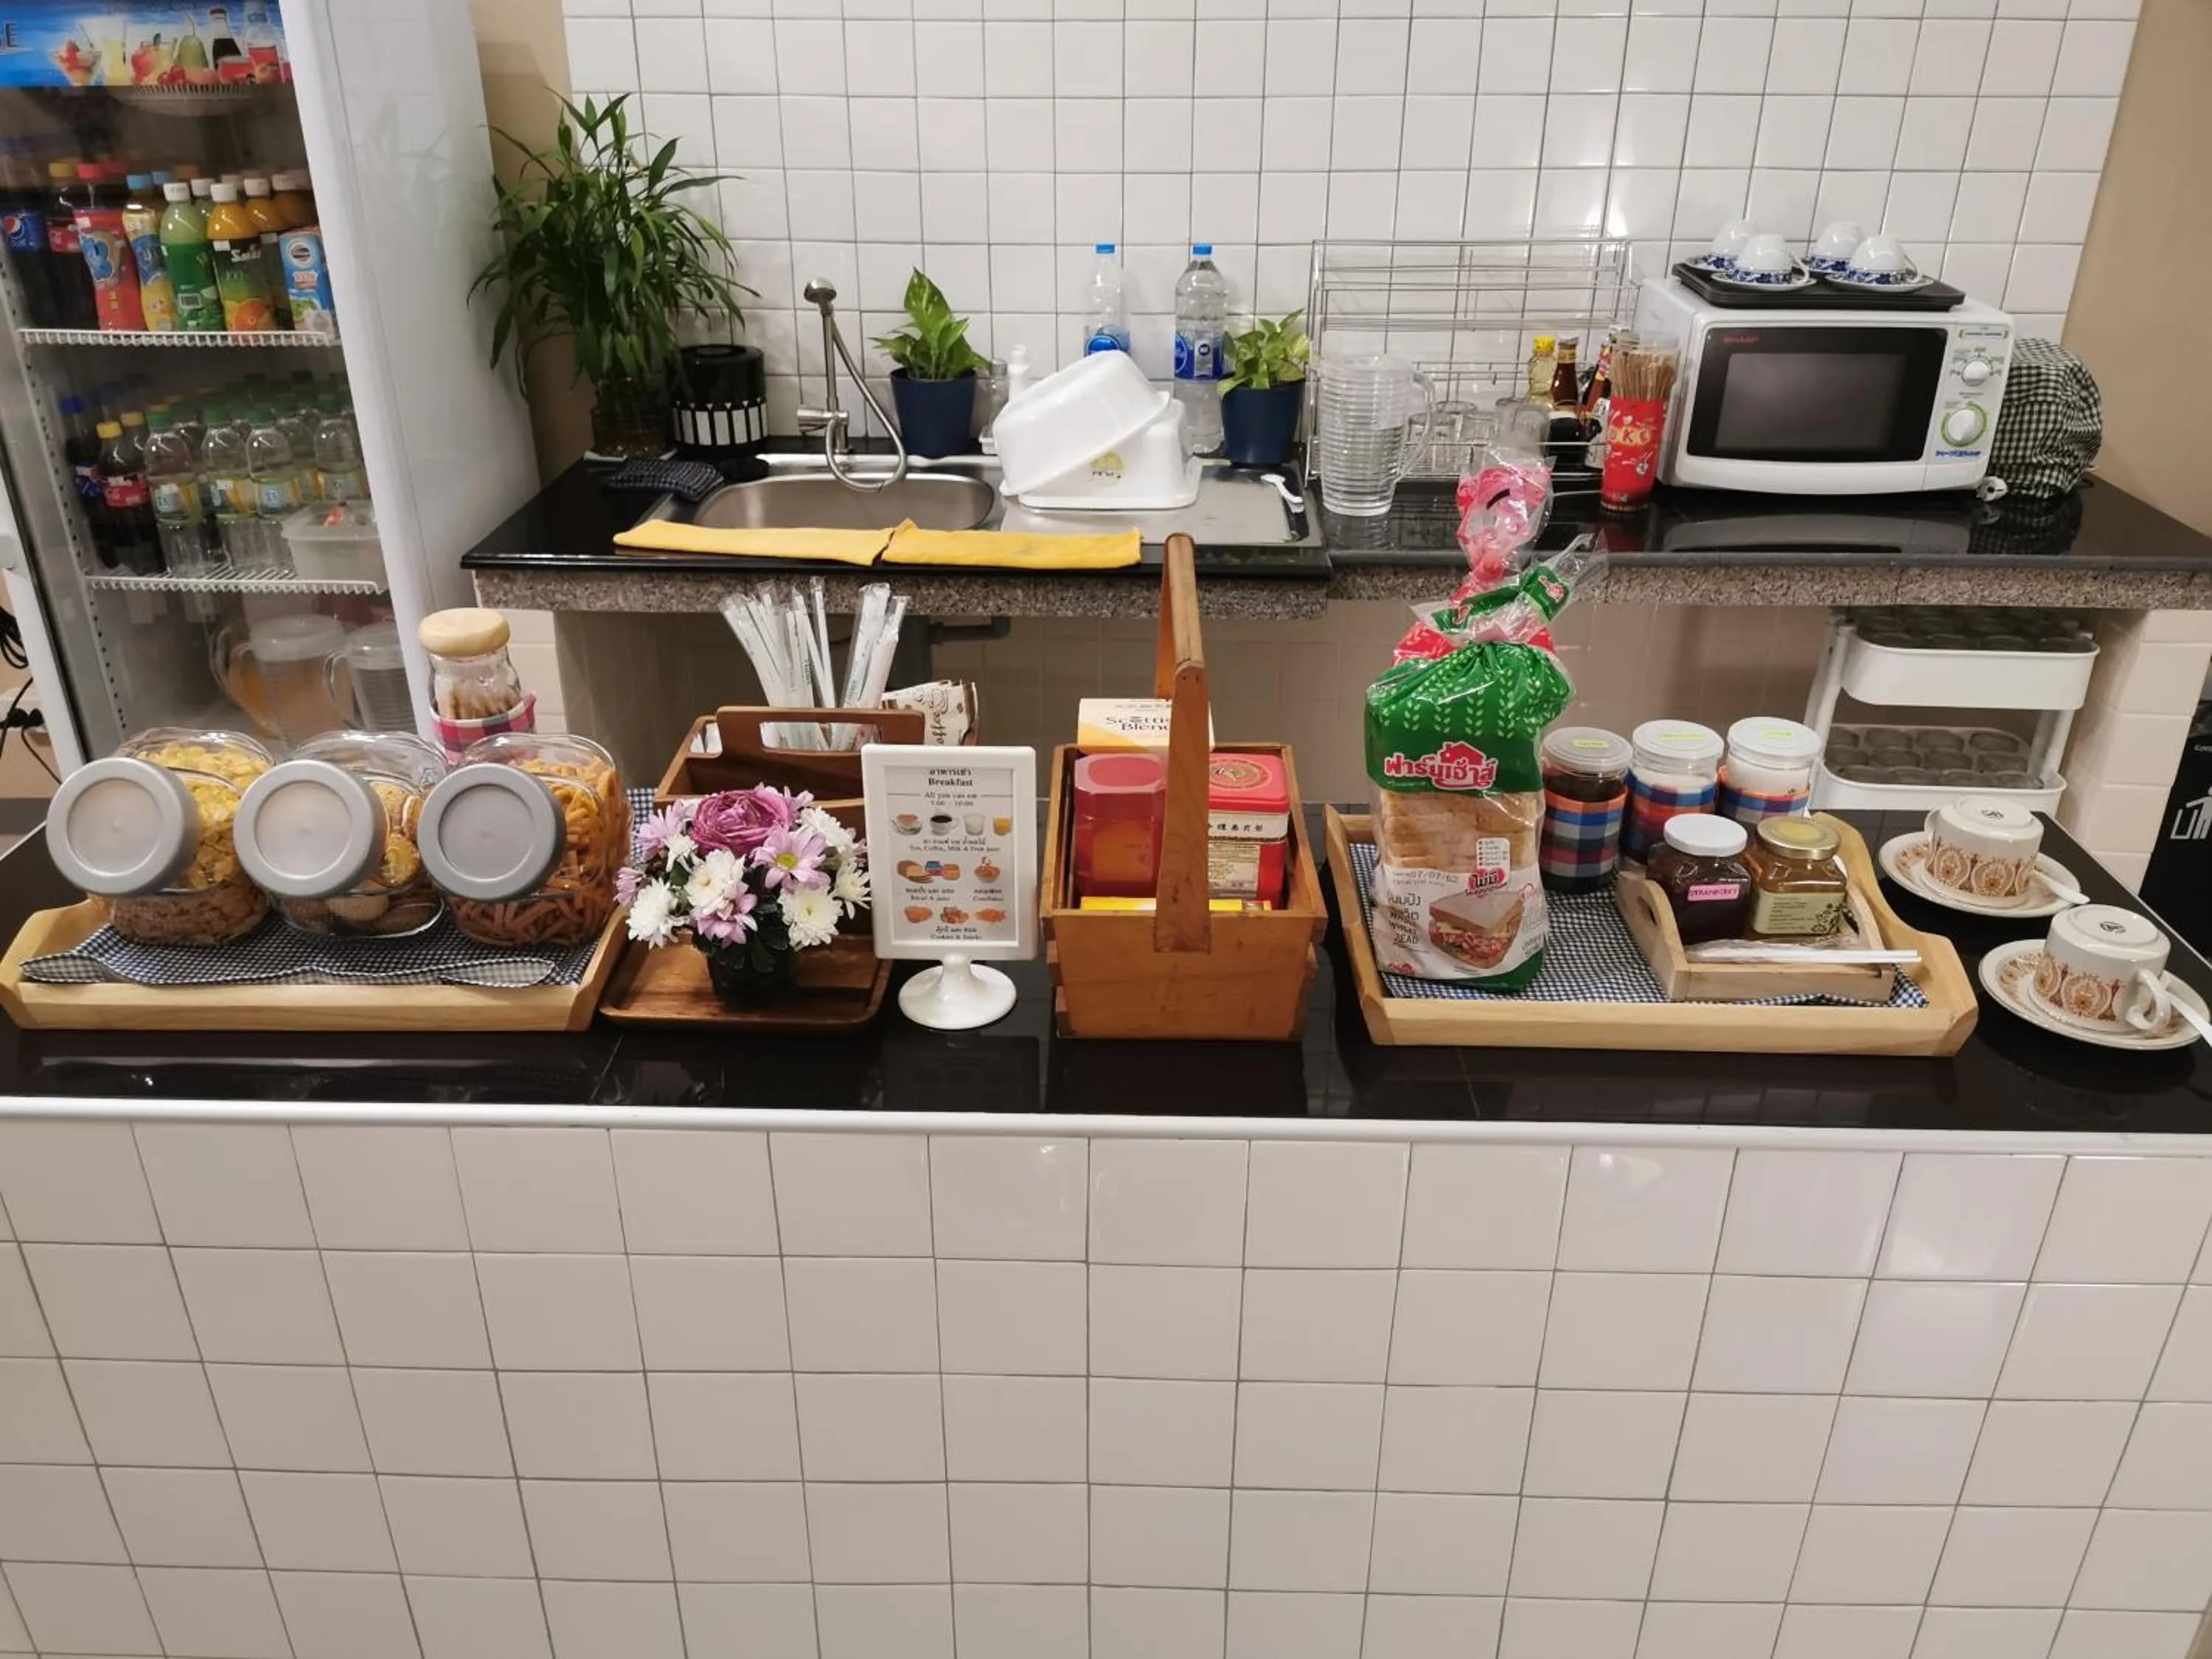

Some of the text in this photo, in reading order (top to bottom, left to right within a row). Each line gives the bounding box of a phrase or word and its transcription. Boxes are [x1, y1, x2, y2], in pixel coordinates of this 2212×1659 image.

[0, 23, 18, 48] E
[928, 778, 973, 787] Breakfast
[1385, 754, 1498, 789] ฟาร์มเฮ้าส์
